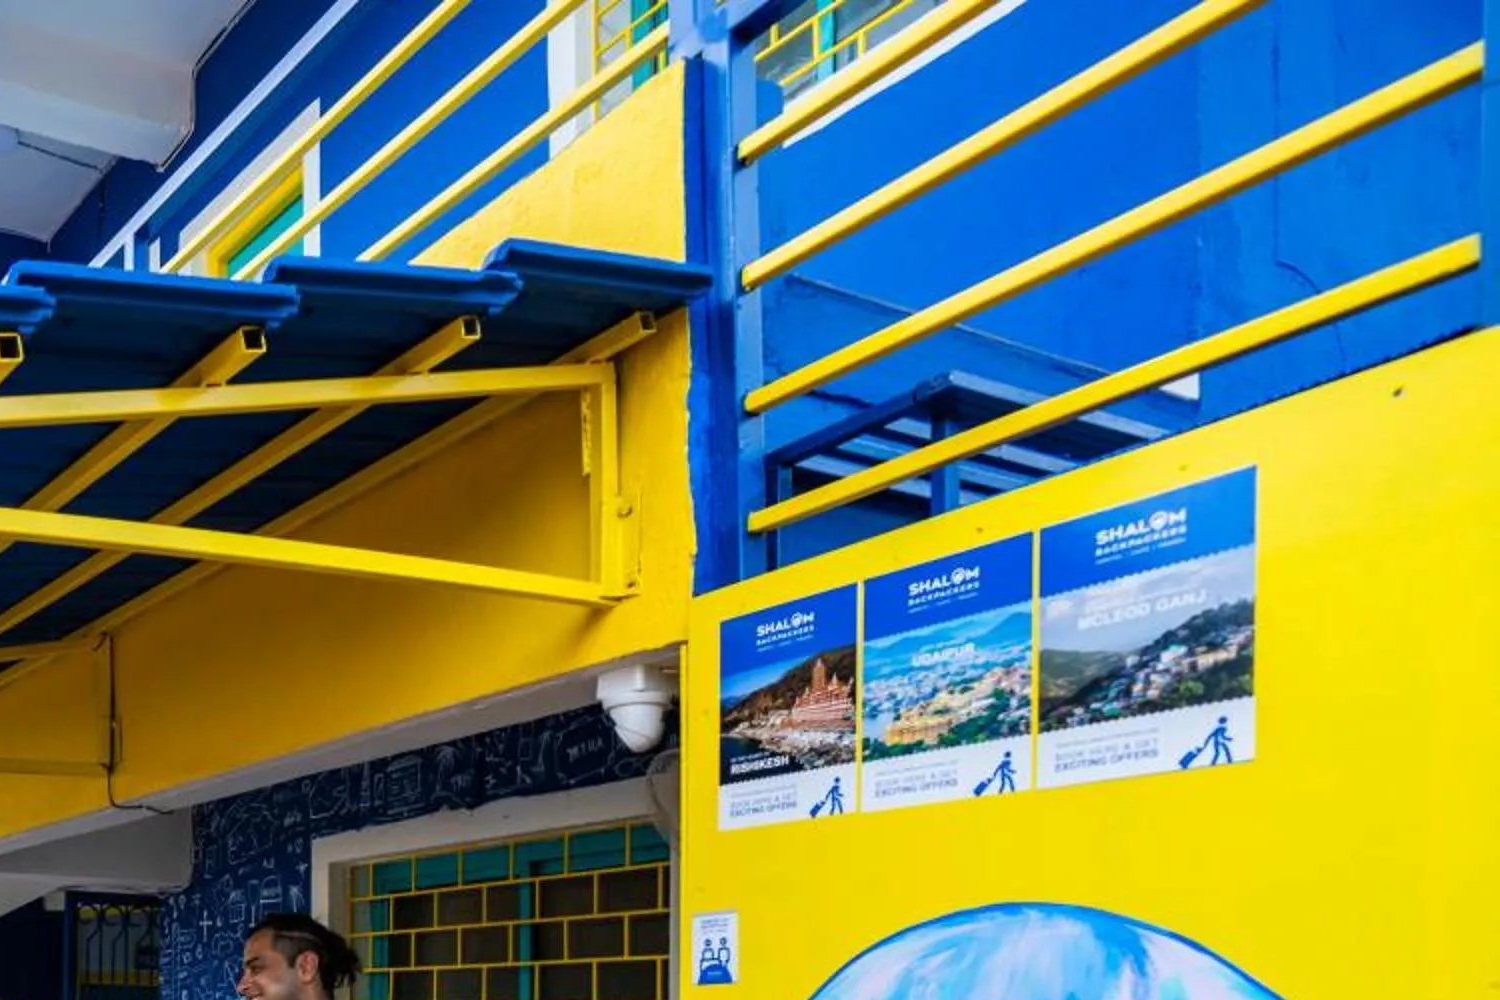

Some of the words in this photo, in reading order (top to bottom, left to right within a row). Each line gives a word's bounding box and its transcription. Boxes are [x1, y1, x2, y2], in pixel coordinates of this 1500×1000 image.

[1095, 507, 1187, 545] SHALOM
[908, 566, 980, 596] SHALOM
[756, 612, 815, 637] SHALOM
